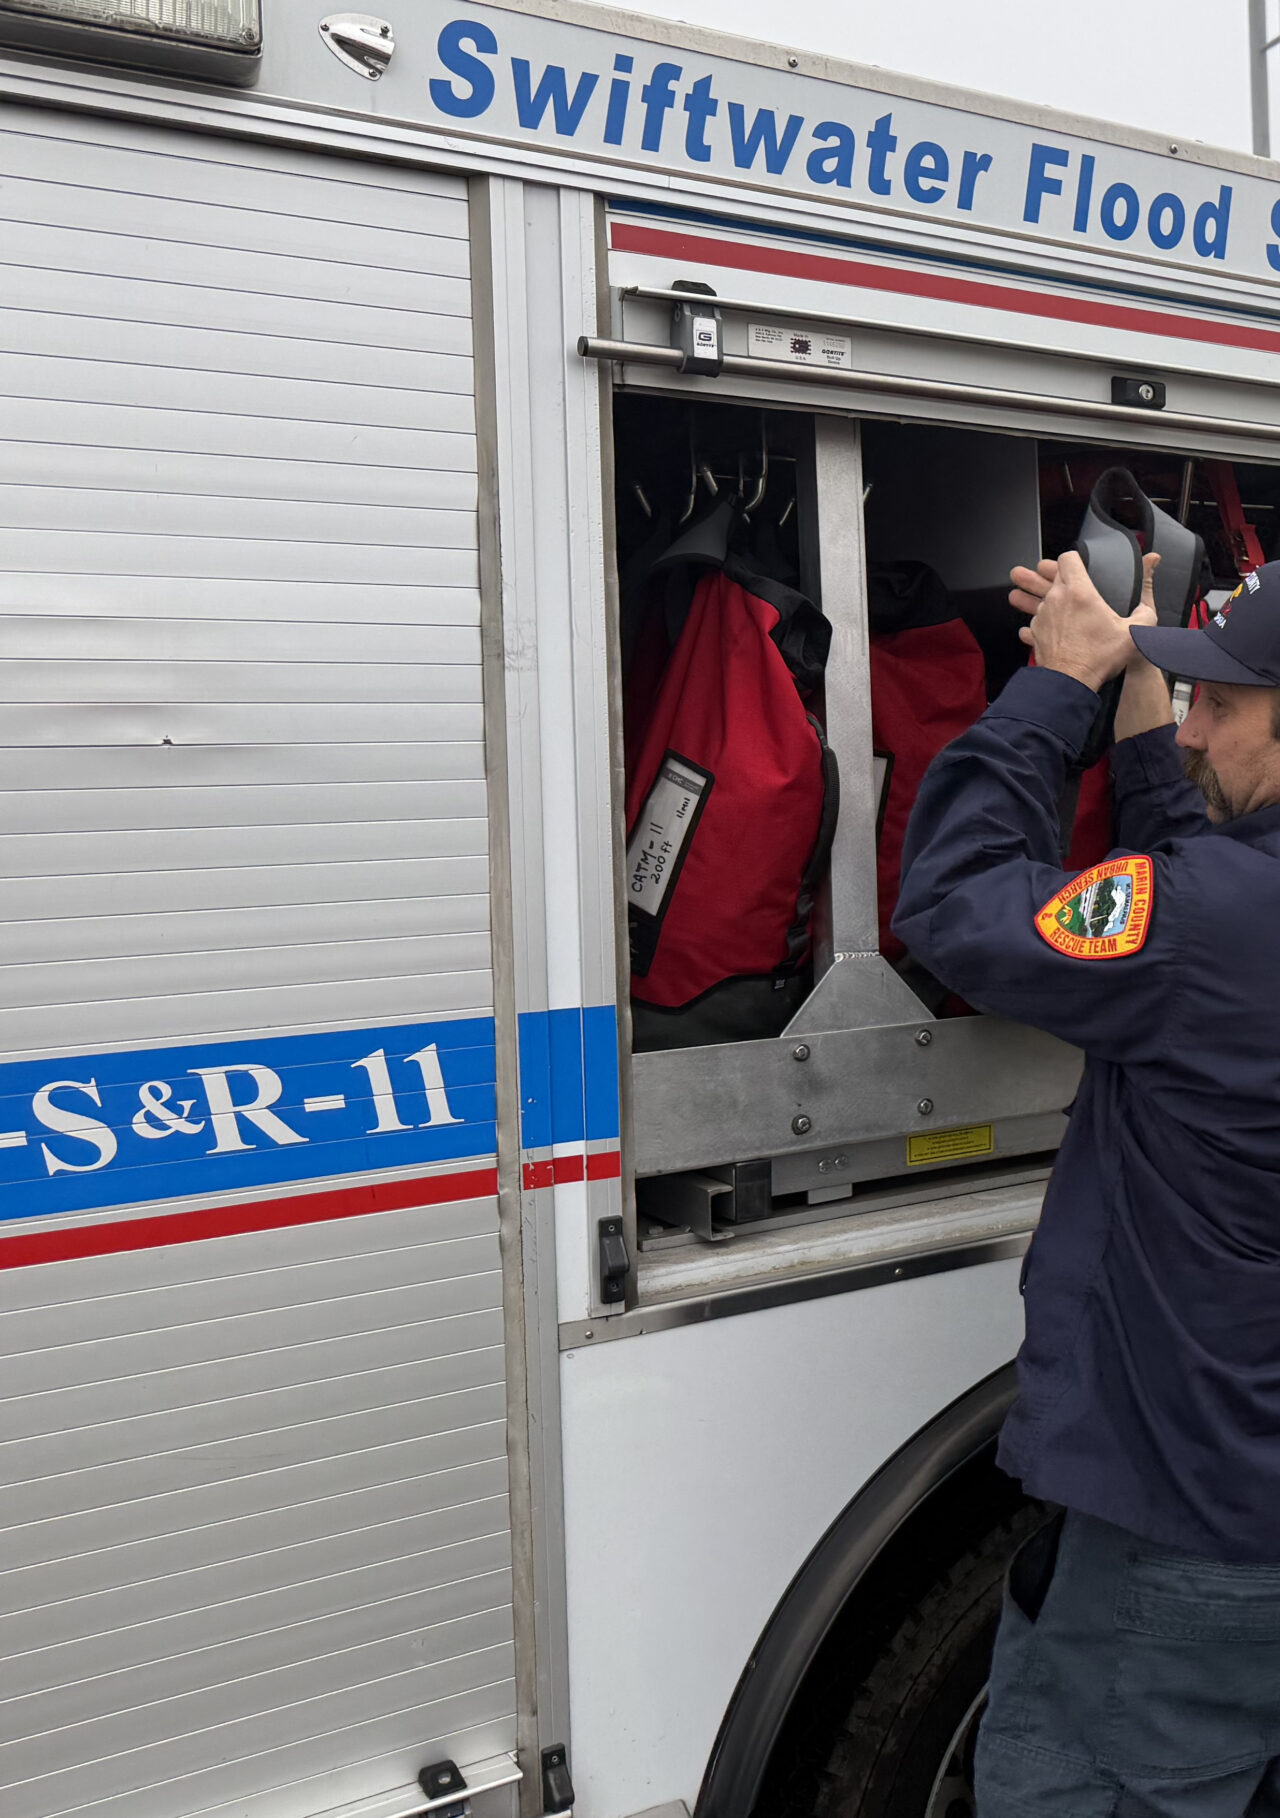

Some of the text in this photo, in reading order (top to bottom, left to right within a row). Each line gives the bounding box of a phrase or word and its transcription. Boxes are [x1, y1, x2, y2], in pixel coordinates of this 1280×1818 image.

[429, 19, 992, 211] Swiftwater
[1023, 142, 1233, 260] Flood
[651, 840, 672, 885] 200 ft
[1097, 861, 1128, 881] URBAN
[1057, 872, 1094, 905] SEARCH
[1126, 861, 1148, 945] MARIN COUNTY
[1049, 927, 1086, 954] RESCUE
[1088, 938, 1117, 954] TEAM
